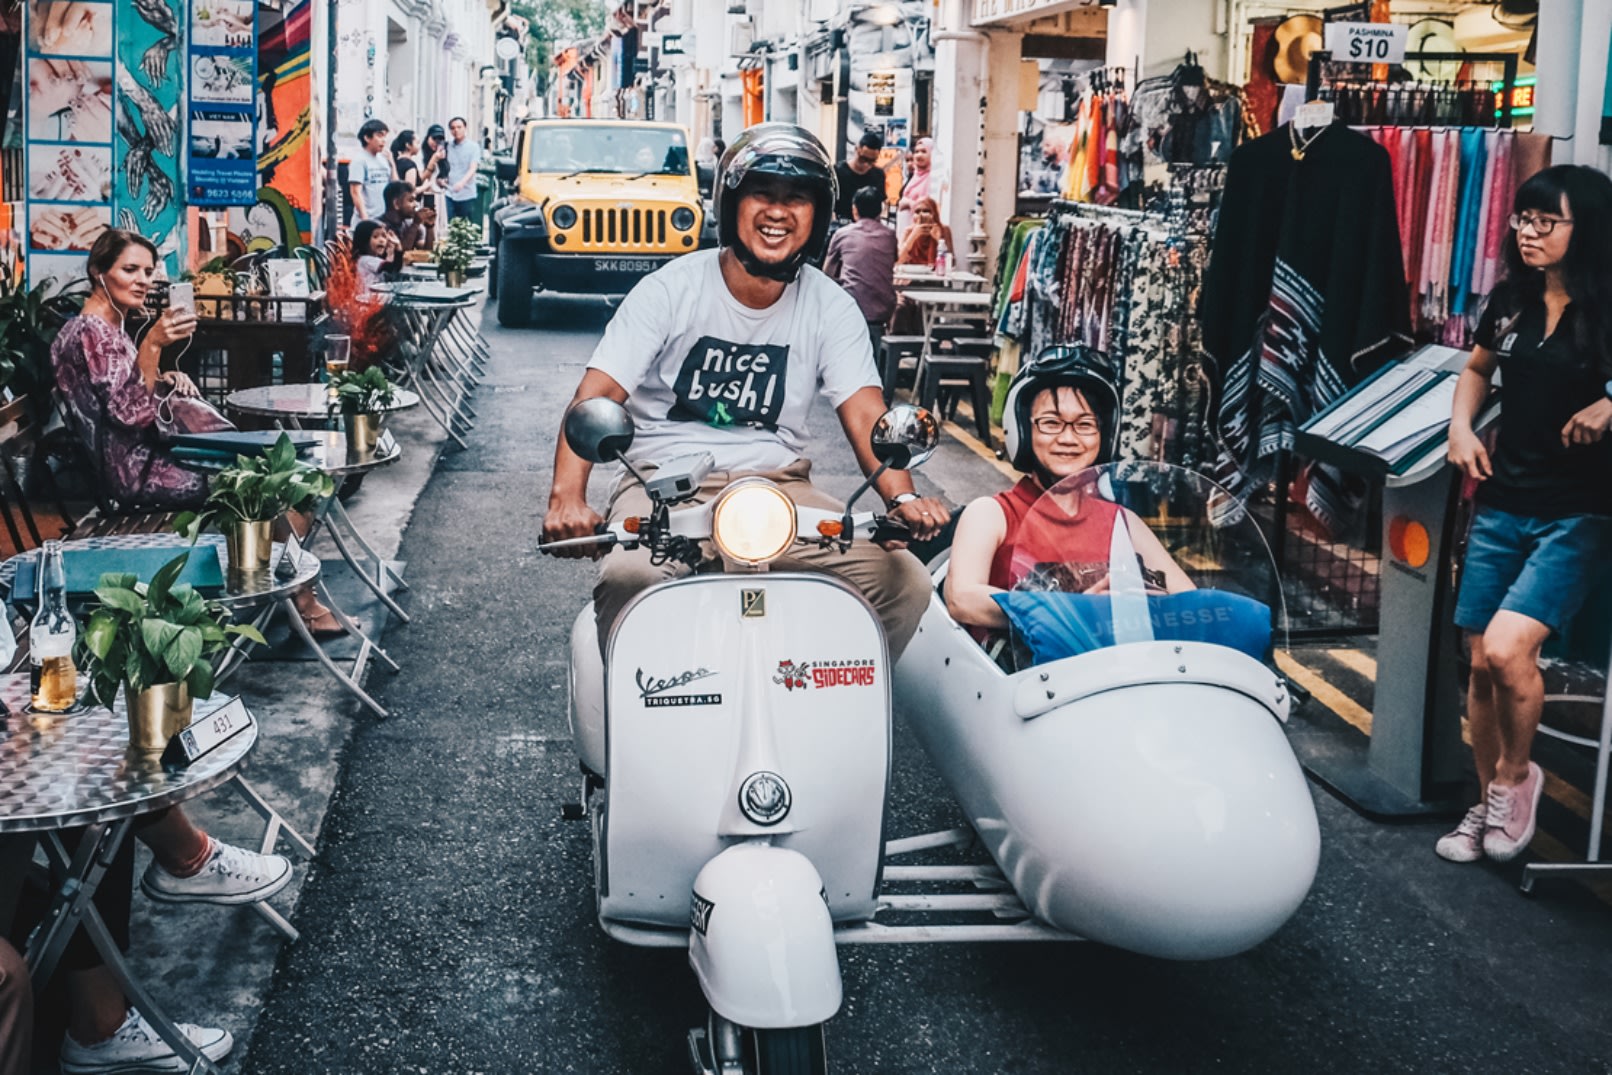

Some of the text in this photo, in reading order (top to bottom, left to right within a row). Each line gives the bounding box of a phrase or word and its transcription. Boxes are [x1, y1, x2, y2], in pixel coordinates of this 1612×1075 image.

[1349, 27, 1394, 37] PASHMINA
[1349, 37, 1389, 58] $10
[702, 346, 770, 373] nice
[688, 369, 777, 415] bush!
[812, 659, 875, 668] SINGAPORE
[636, 667, 719, 699] Vespa
[812, 667, 875, 689] SIDECARS
[212, 714, 233, 734] 431
